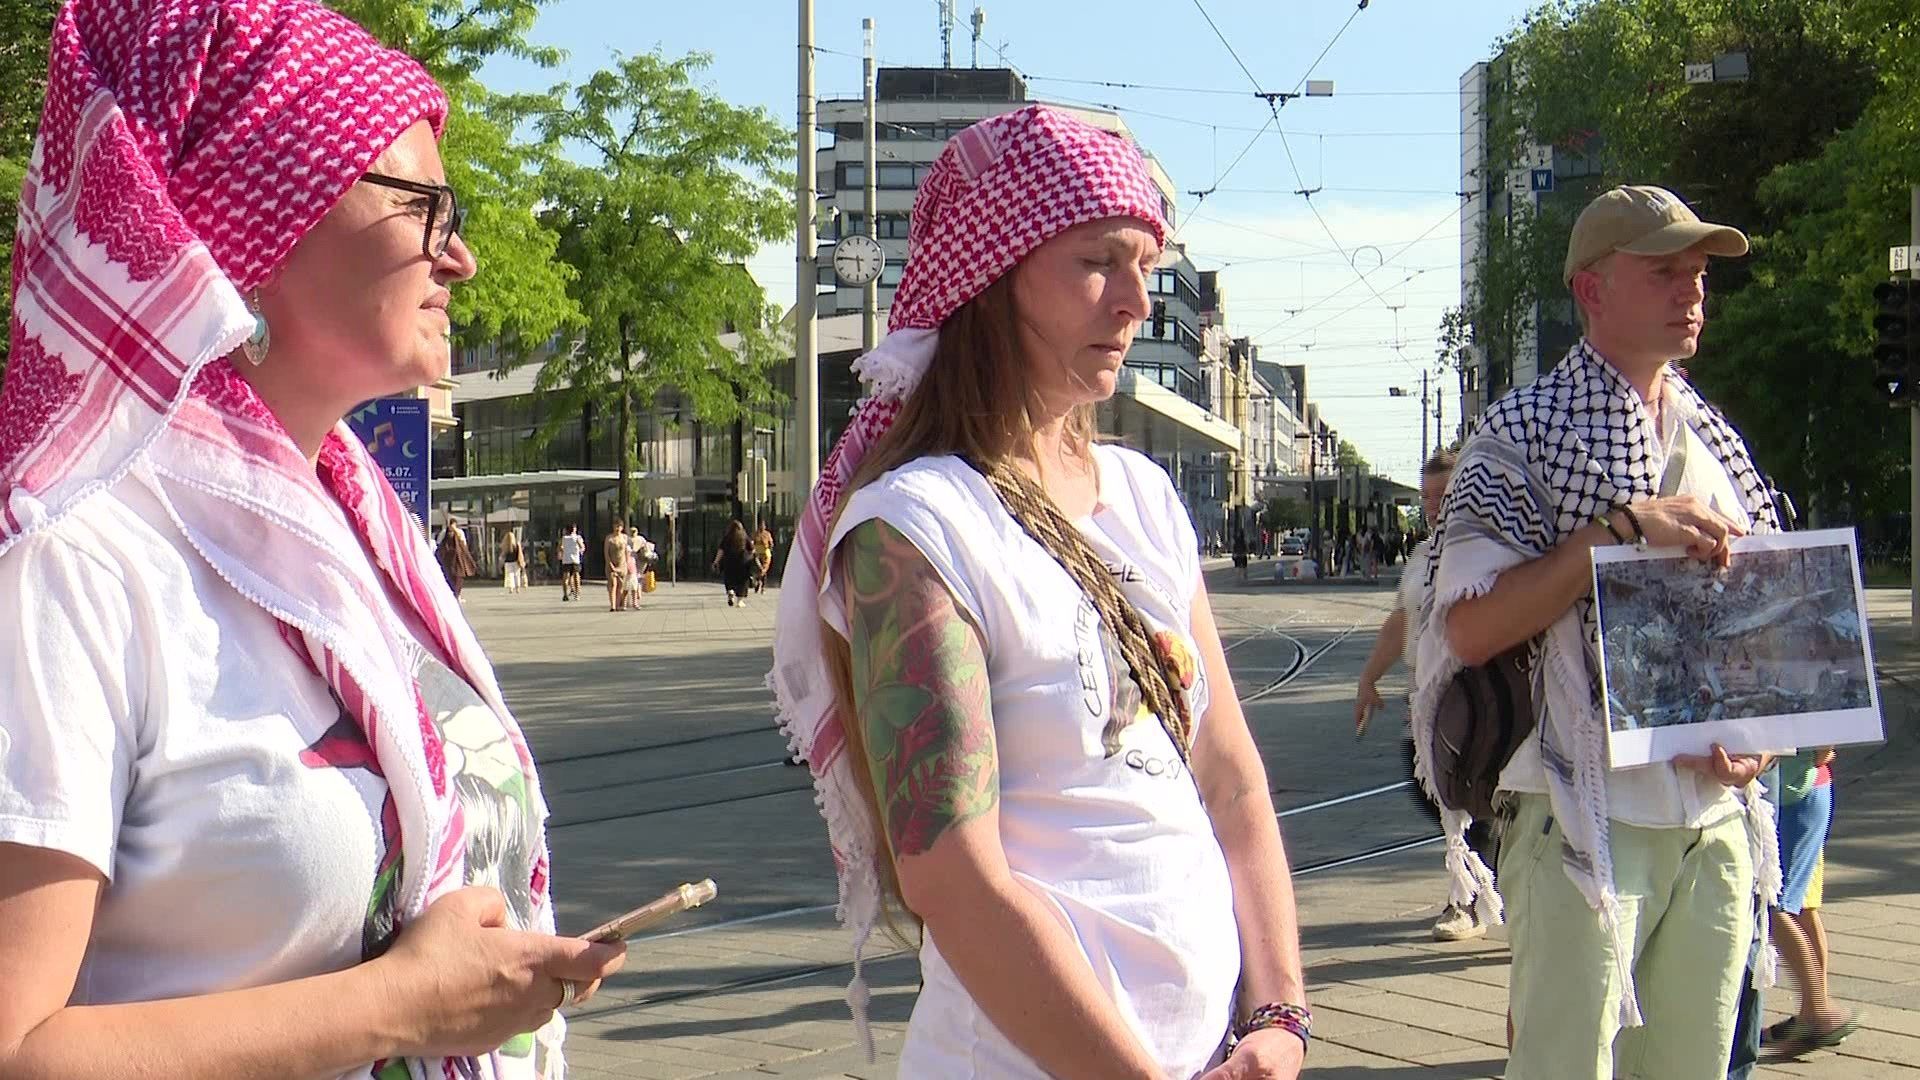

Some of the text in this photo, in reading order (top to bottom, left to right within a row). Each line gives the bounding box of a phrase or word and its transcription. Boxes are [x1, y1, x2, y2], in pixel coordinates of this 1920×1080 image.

[1537, 174, 1547, 187] W
[1894, 248, 1904, 258] A2
[390, 481, 412, 490] GER
[397, 490, 419, 503] er
